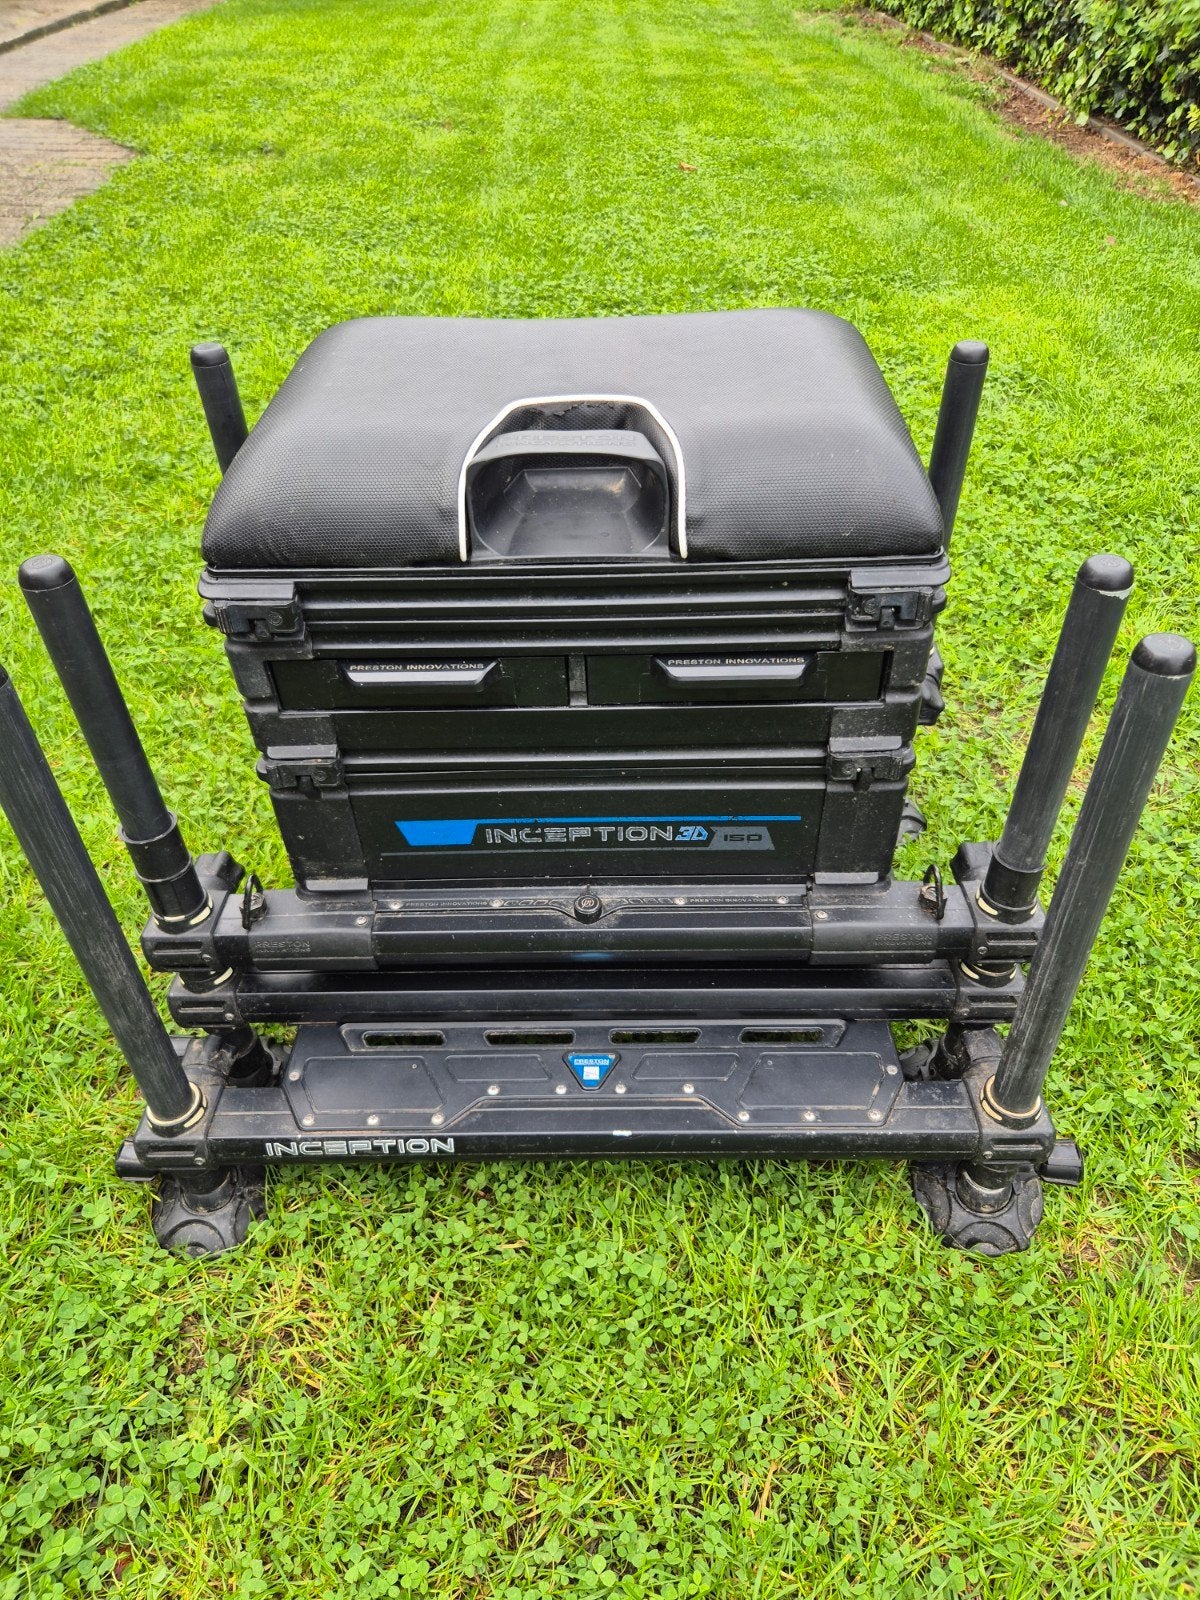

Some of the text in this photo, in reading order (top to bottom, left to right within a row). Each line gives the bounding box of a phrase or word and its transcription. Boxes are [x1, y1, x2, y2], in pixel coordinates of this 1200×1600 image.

[349, 662, 485, 672] PRESTON INNOVATIONS
[668, 655, 806, 666] PRESTON INNOVATIONS
[485, 825, 673, 844] INCEPTION
[265, 1137, 455, 1157] INCEPTION
